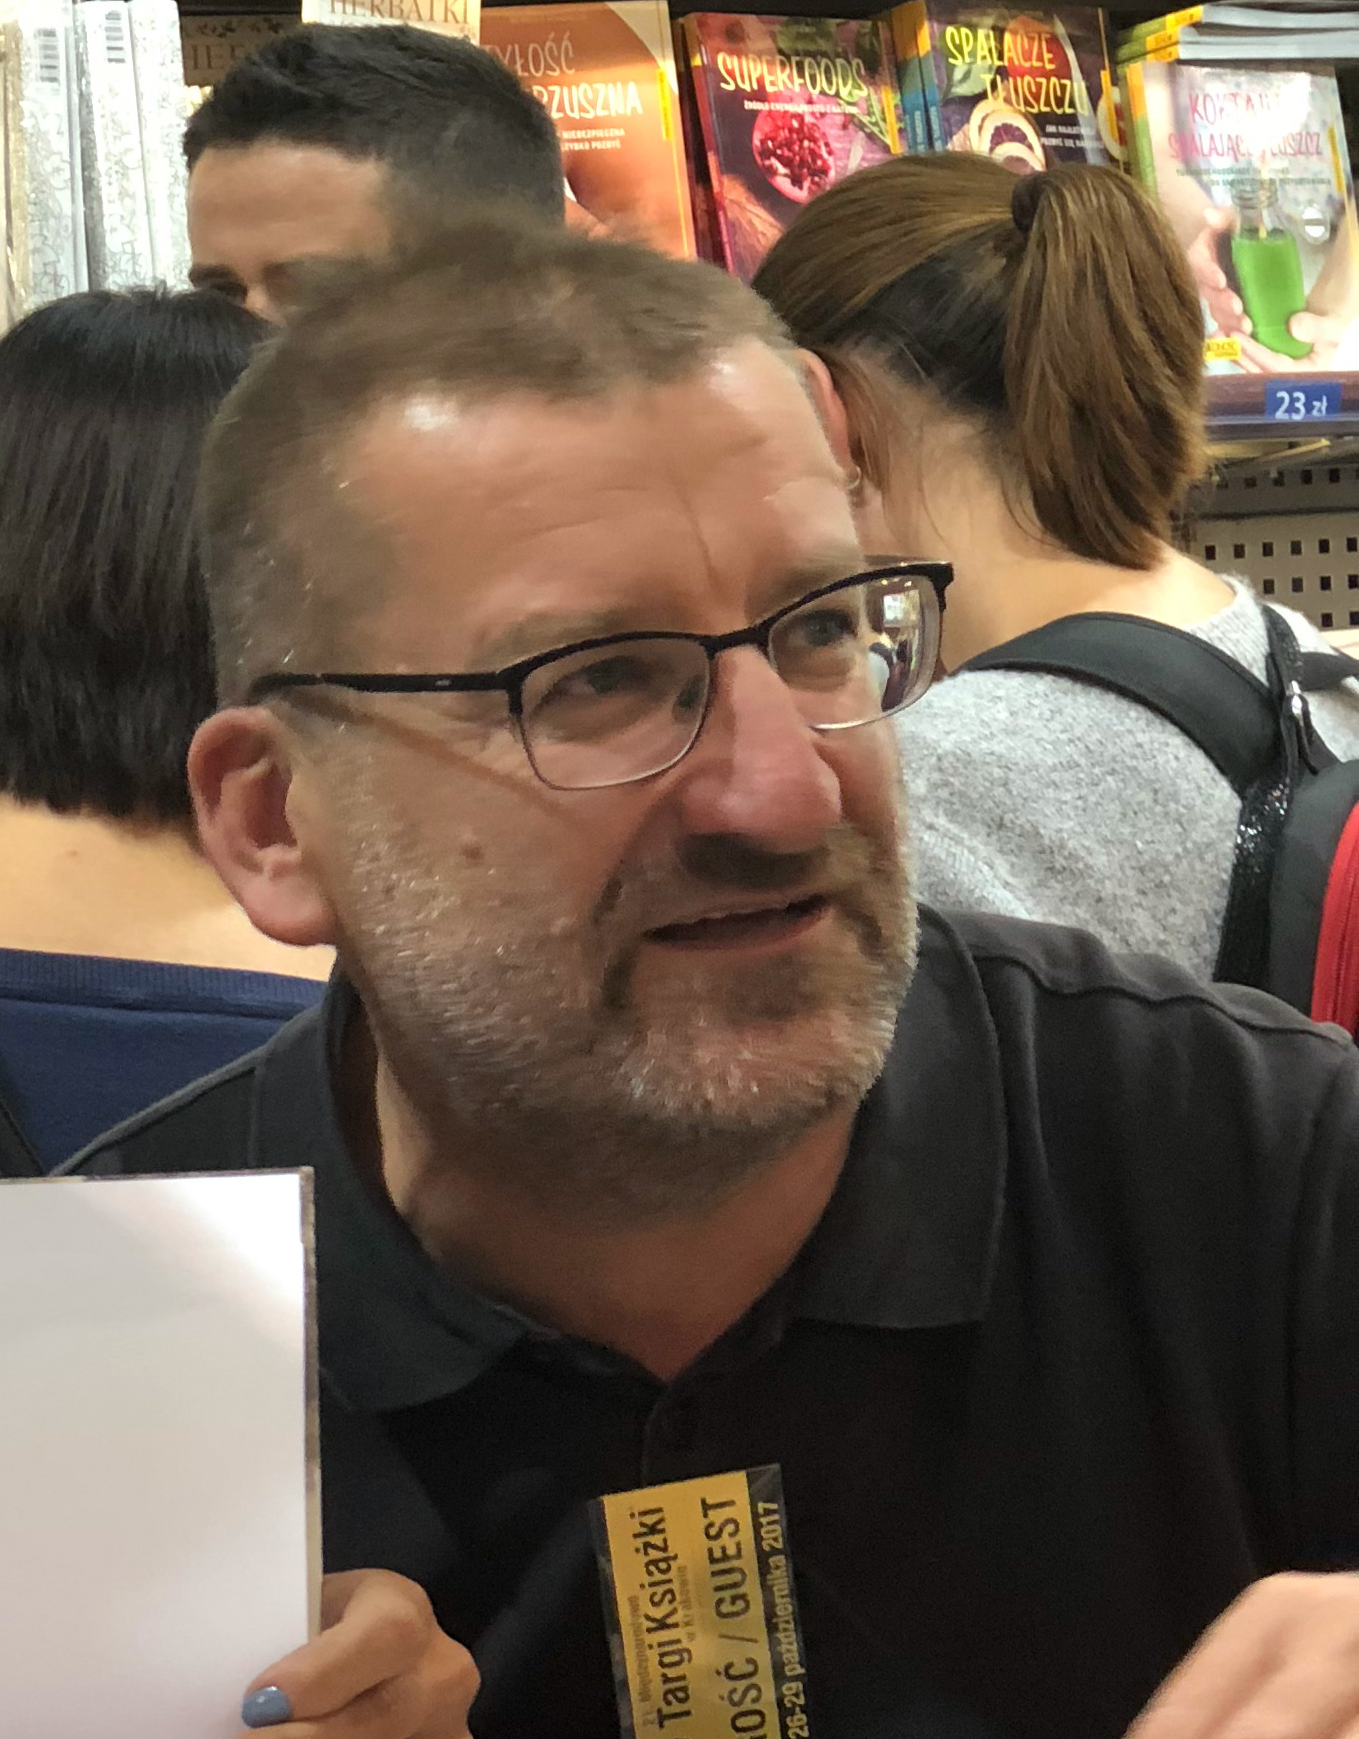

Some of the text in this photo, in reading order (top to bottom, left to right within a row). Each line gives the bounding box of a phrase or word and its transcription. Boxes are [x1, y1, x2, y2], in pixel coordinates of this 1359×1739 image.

[945, 26, 1056, 70] SPALACZE
[717, 52, 869, 102] SUPERFOODS
[1275, 391, 1328, 420] 23 zł
[757, 1501, 784, 1552] 2017
[701, 1496, 751, 1620] GUEST
[629, 1506, 693, 1731] Targi Książki
[767, 1555, 807, 1677] października
